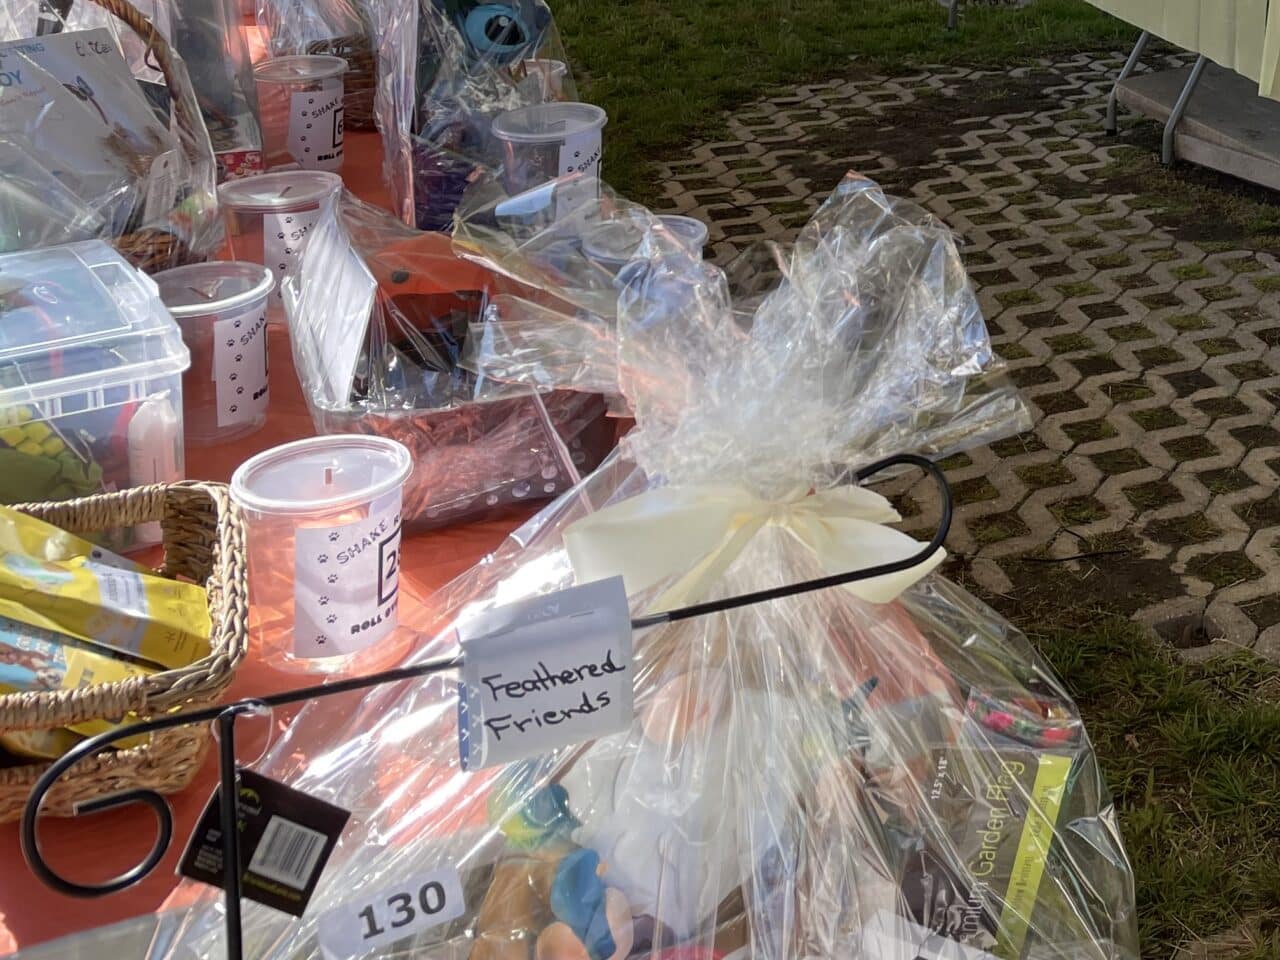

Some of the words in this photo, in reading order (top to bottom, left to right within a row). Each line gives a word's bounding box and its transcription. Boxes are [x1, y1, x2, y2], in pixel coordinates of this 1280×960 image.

[336, 520, 387, 565] SHAKE
[350, 614, 382, 635] ROLL
[481, 649, 626, 701] Feathered
[484, 691, 611, 741] Friends
[969, 806, 1004, 878] Garden
[987, 760, 1026, 801] Flag
[357, 880, 447, 940] 130
